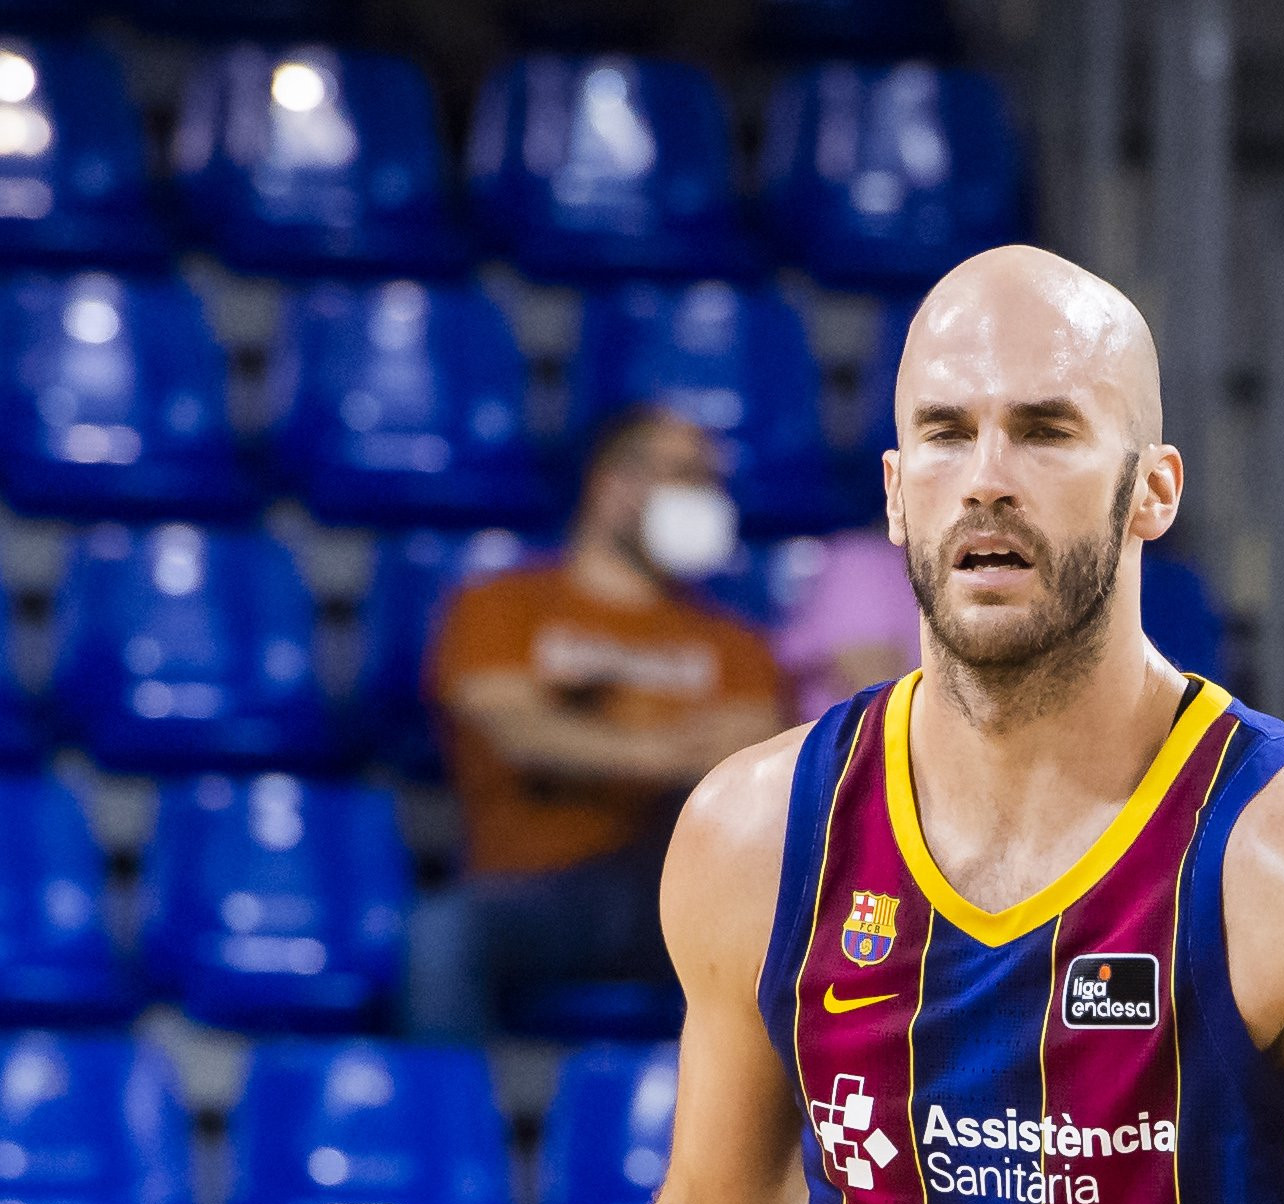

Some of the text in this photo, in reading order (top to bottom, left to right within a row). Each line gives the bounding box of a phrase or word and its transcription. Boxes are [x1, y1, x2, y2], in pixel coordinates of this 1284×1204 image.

[1072, 976, 1107, 1000] liga
[1071, 998, 1150, 1018] endesa
[922, 1104, 1176, 1158] Assistència
[927, 1151, 1100, 1204] Sanitària
